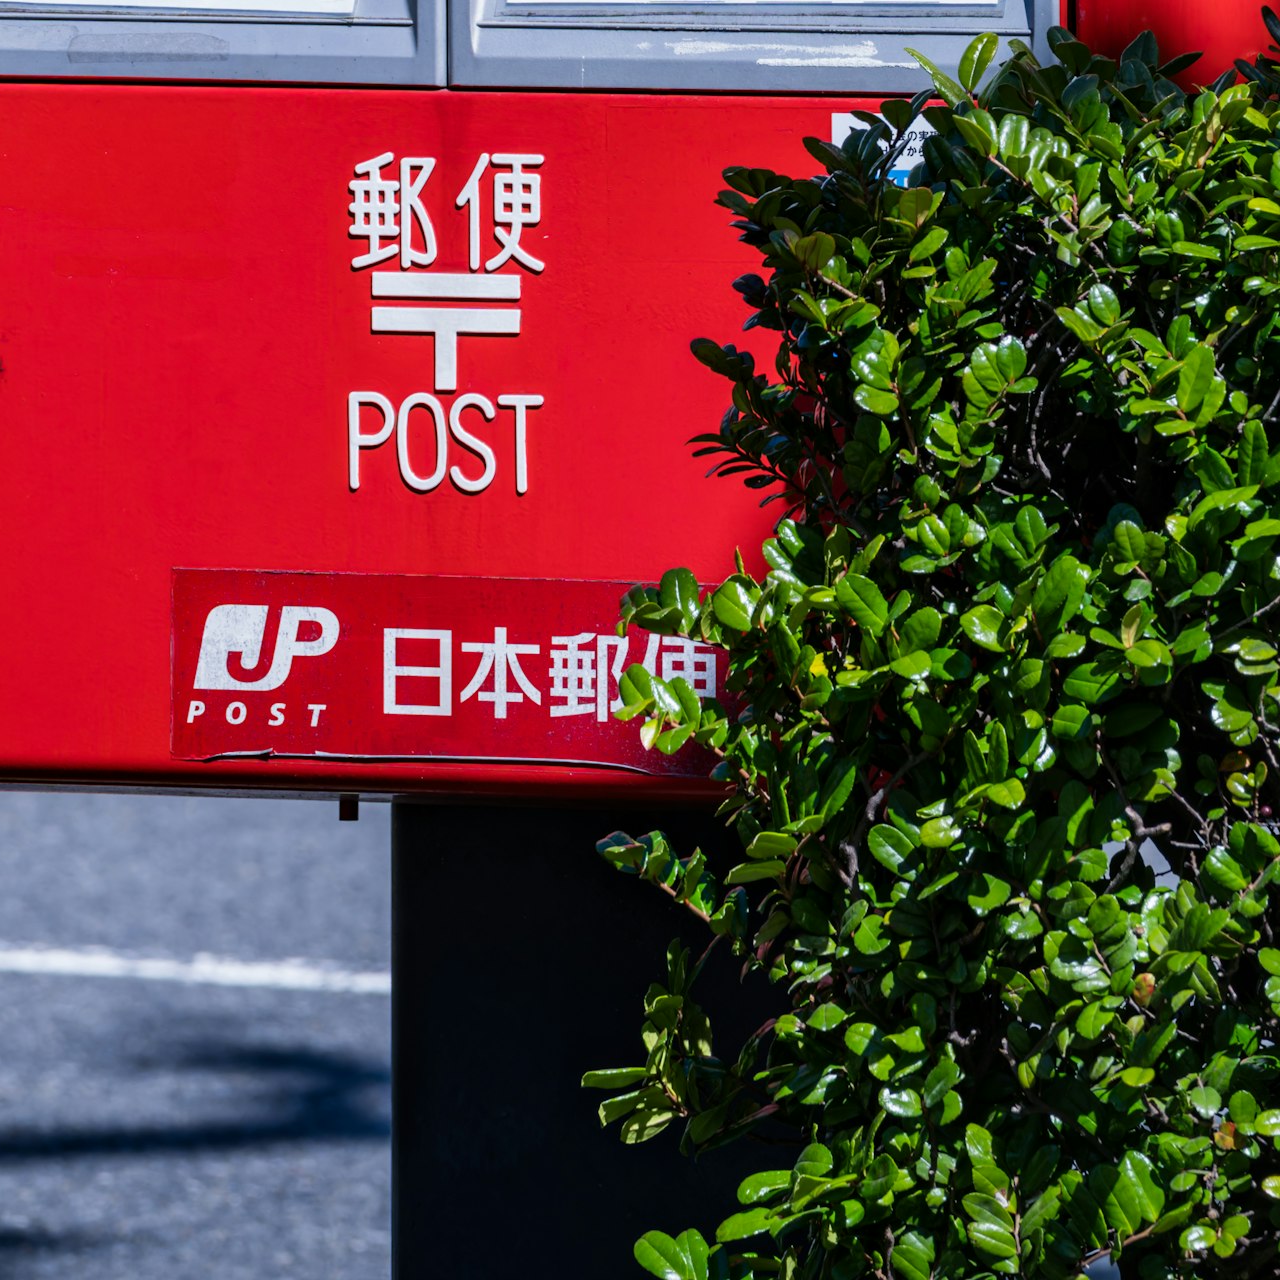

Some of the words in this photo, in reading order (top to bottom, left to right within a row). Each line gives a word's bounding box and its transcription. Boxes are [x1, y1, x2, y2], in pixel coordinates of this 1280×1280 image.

[349, 151, 545, 273] 郵便
[347, 391, 545, 494] POST
[186, 700, 327, 727] POST
